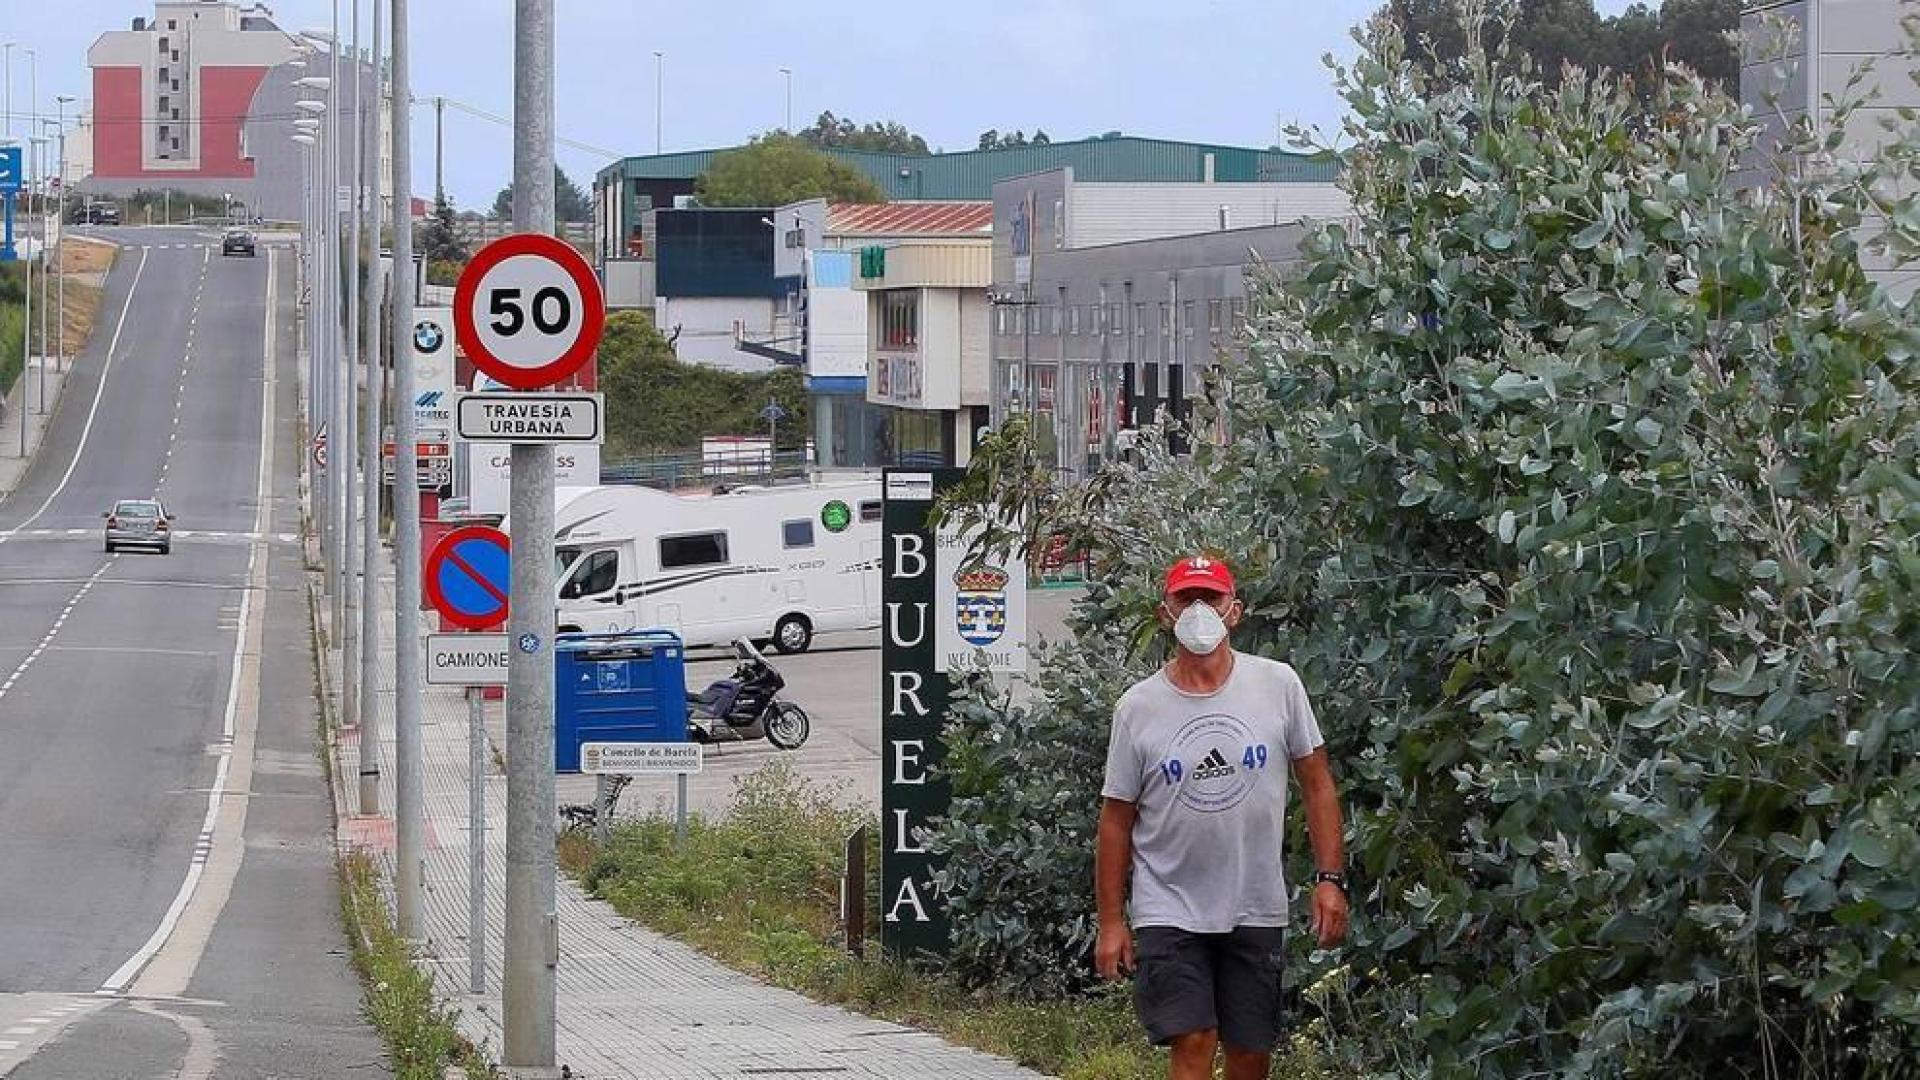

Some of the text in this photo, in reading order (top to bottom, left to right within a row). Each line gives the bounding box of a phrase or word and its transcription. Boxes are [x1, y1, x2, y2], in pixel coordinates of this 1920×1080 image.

[490, 287, 571, 337] 50
[483, 403, 573, 418] TRAVESÍA
[490, 421, 565, 434] URBANA
[436, 652, 508, 668] CAMIONE
[948, 652, 1012, 666] WELOME
[885, 533, 931, 922] BURELA
[649, 748, 661, 757] de
[1242, 744, 1267, 770] 49
[1161, 759, 1182, 786] 19
[1193, 765, 1236, 780] adidas
